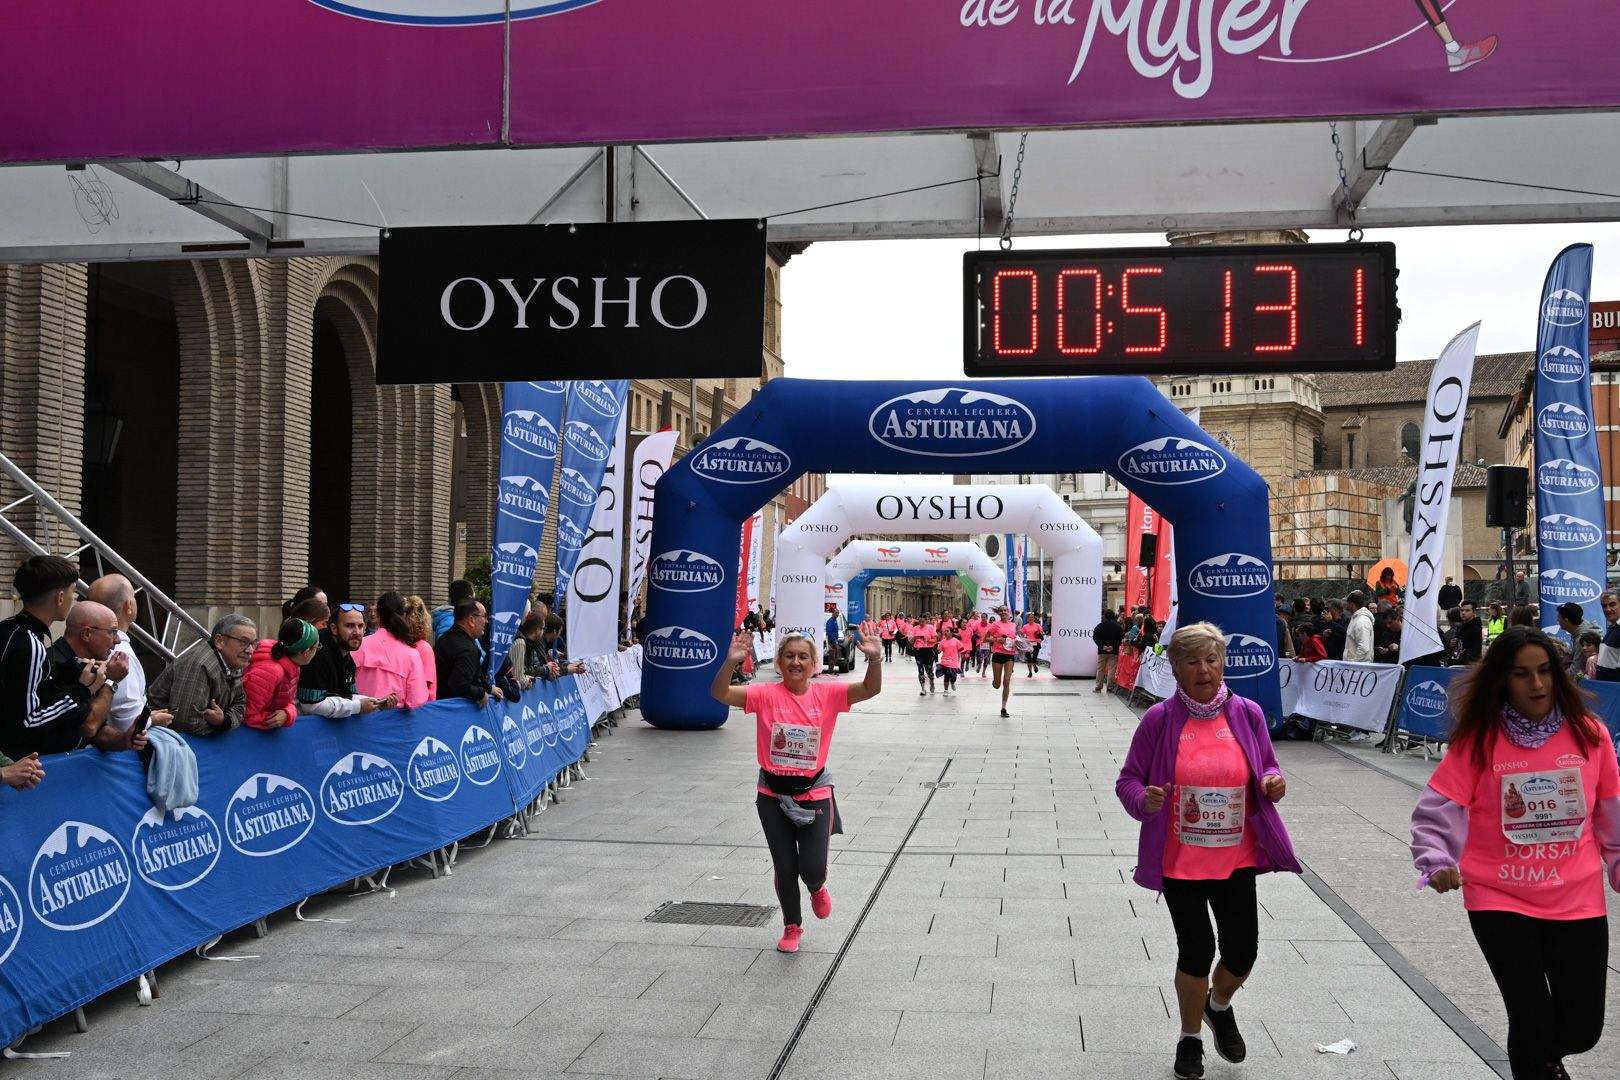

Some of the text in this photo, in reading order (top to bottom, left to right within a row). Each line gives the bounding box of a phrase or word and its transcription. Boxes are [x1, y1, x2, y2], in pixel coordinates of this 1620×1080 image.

[440, 275, 708, 331] OYSHO
[1543, 358, 1583, 374] ASTURIANA
[907, 408, 1018, 416] CENTRAL LECHERA
[881, 409, 1023, 439] ASTURIANA
[1541, 415, 1588, 432] ASTURIANA
[504, 418, 557, 454] ASTURIANA
[565, 426, 605, 459] ASTURIANA
[696, 453, 783, 473] ASTURIANA
[1127, 456, 1220, 474] ASTURIANA
[1411, 377, 1463, 599] OYSHO
[1539, 470, 1595, 488] ASTURIANA
[876, 494, 1004, 520] OYSHO
[800, 524, 839, 533] OYSHO
[1040, 522, 1079, 532] OYSHO
[652, 563, 718, 583] ASTURIANA
[782, 574, 817, 584] OYSHO
[1060, 575, 1097, 585] OYSHO
[1194, 571, 1268, 588] ASTURIANA
[646, 640, 712, 660] ASTURIANA
[1224, 654, 1271, 667] URIANA
[1314, 666, 1378, 698] OYSHO
[1409, 692, 1445, 711] ASTURIANA
[464, 749, 500, 774] ASTURIANA
[1493, 760, 1529, 772] OYSHO
[414, 763, 459, 789] ASTURIANA
[329, 778, 400, 814] ASTURIANA
[1523, 785, 1555, 793] ASTURIANA
[242, 791, 302, 816] CENTRAL LECHERA
[1527, 799, 1557, 811] 016
[234, 802, 311, 844] ASTURIANA
[1202, 811, 1226, 820] 016
[149, 828, 179, 843] CENTRAL
[50, 844, 117, 877] CENTRAL LECHERA
[141, 832, 217, 874] ASTURIANA
[1498, 864, 1561, 881] SUMA
[39, 859, 128, 916] ASTURIANA
